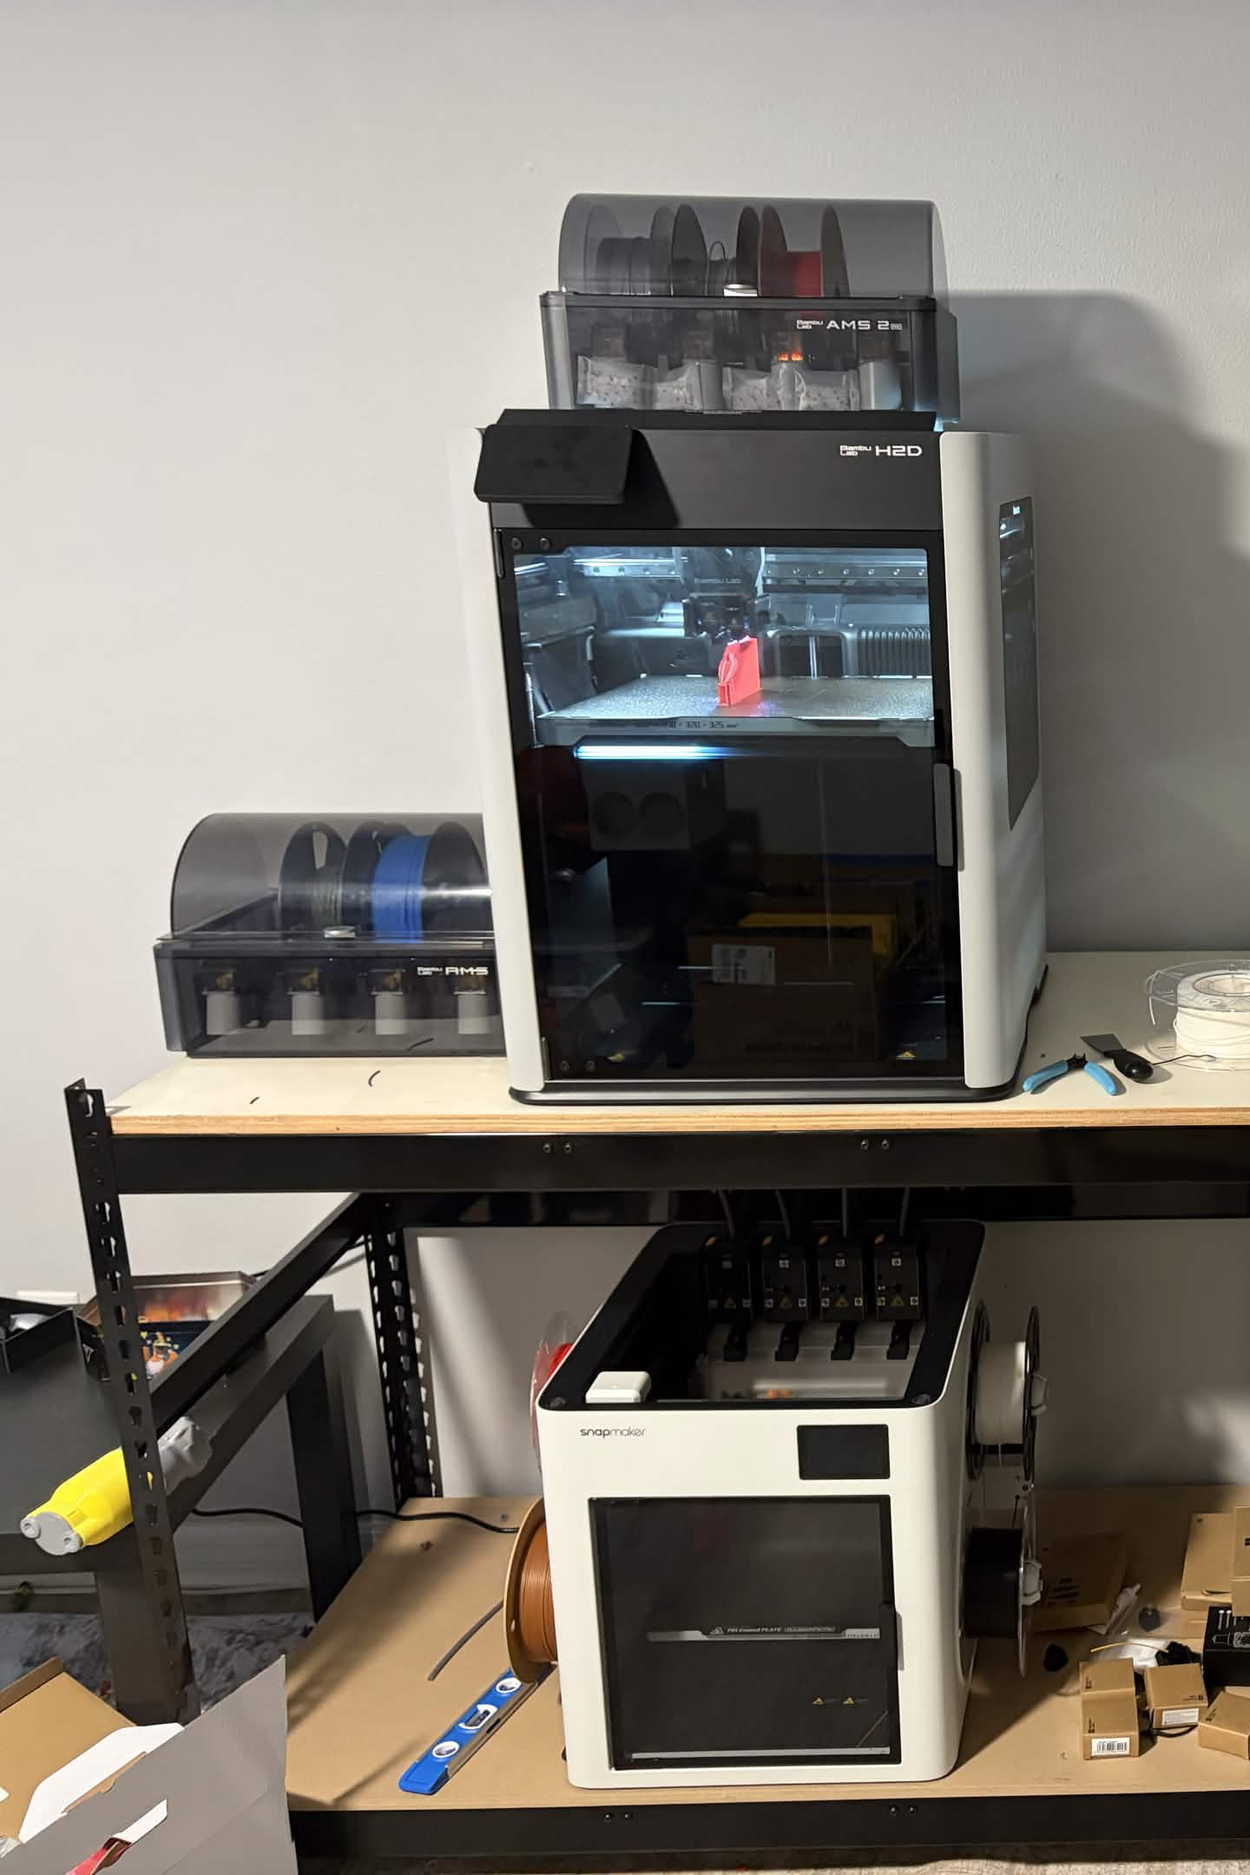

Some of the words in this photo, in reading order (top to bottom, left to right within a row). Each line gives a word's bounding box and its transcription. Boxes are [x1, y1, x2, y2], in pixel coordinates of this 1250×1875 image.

[826, 320, 871, 330] AMS
[877, 320, 890, 330] 2
[875, 445, 923, 456] H2D
[445, 966, 489, 976] AMS
[579, 1426, 646, 1440] snapmaker
